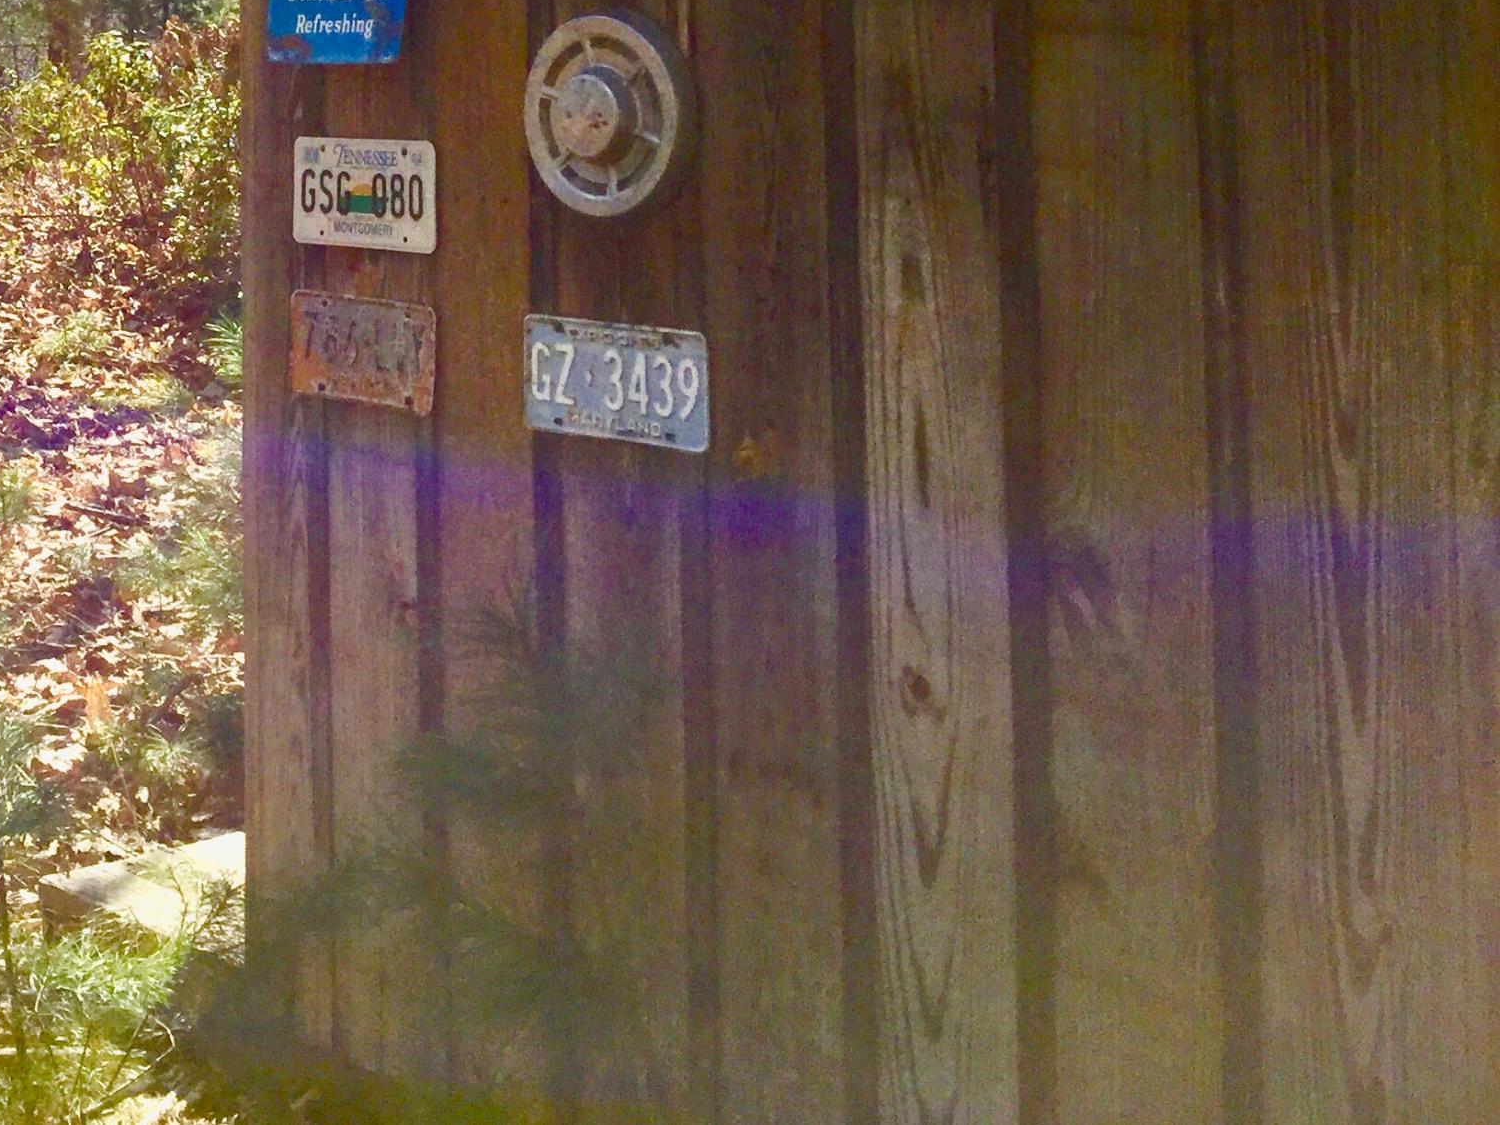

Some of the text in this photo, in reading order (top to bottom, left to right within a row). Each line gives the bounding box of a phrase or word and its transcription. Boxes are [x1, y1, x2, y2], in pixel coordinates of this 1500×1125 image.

[295, 12, 374, 39] Refreshing
[333, 221, 394, 236] MONTGOMERY
[602, 348, 699, 421] 3439
